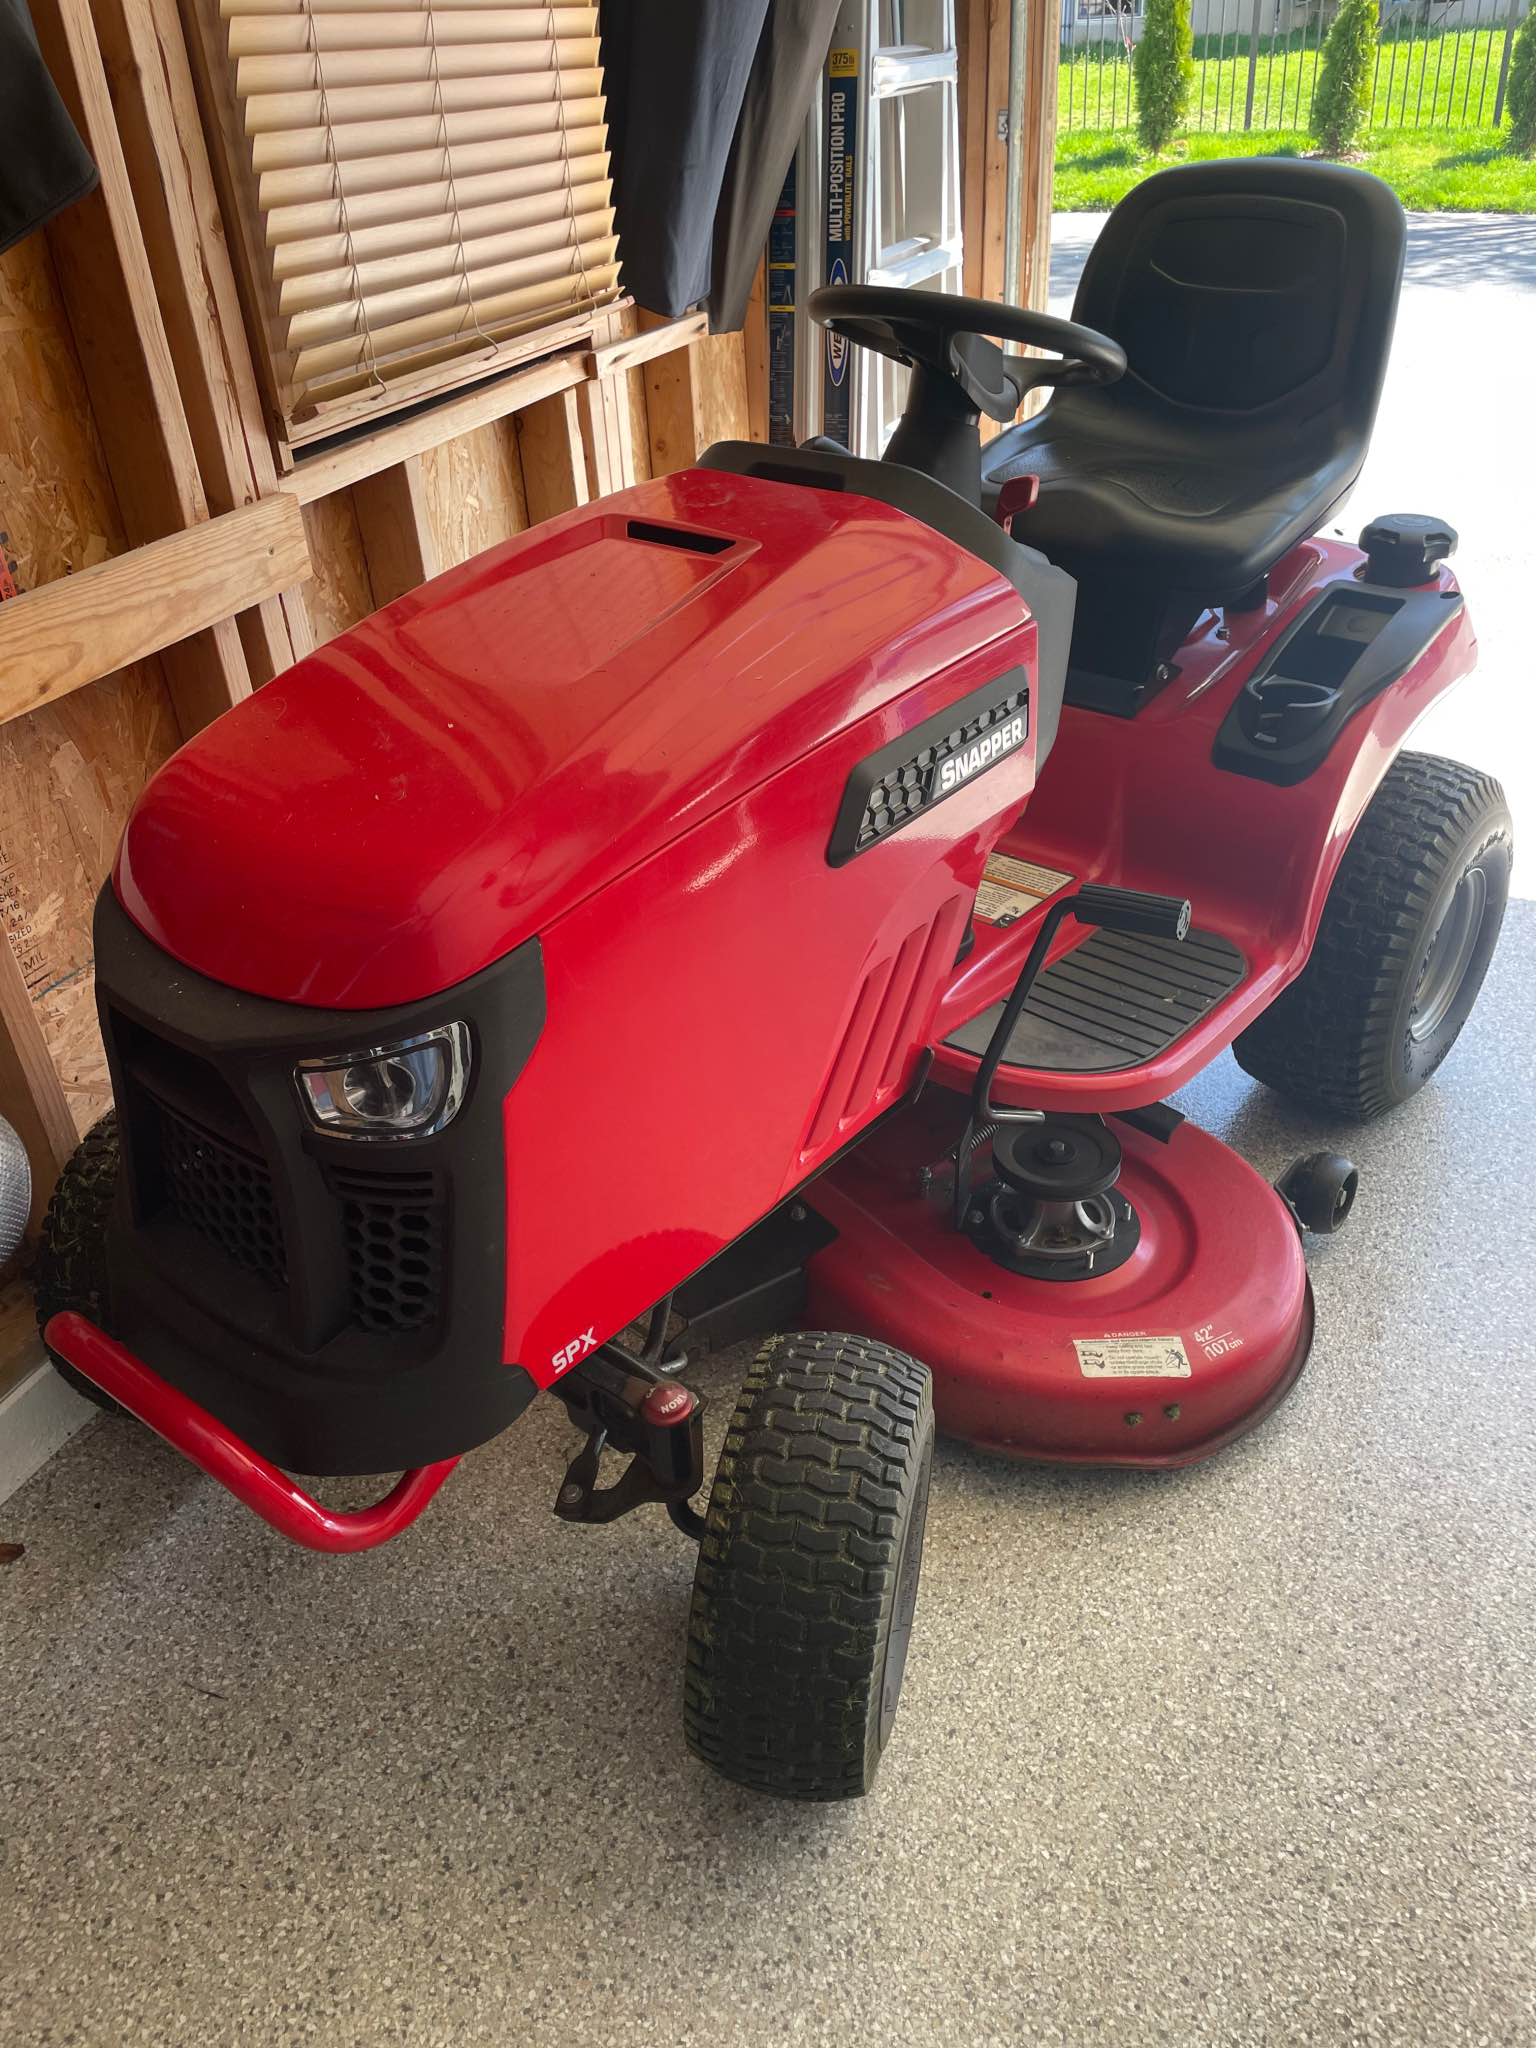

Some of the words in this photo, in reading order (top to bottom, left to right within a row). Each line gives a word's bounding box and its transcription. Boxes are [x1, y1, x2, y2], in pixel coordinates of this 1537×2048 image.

[831, 92, 846, 123] PRO
[829, 124, 845, 242] MULTI-POSITION
[940, 717, 1023, 791] SNAPPER
[8, 924, 32, 945] SIZED
[551, 1326, 598, 1374] SPX
